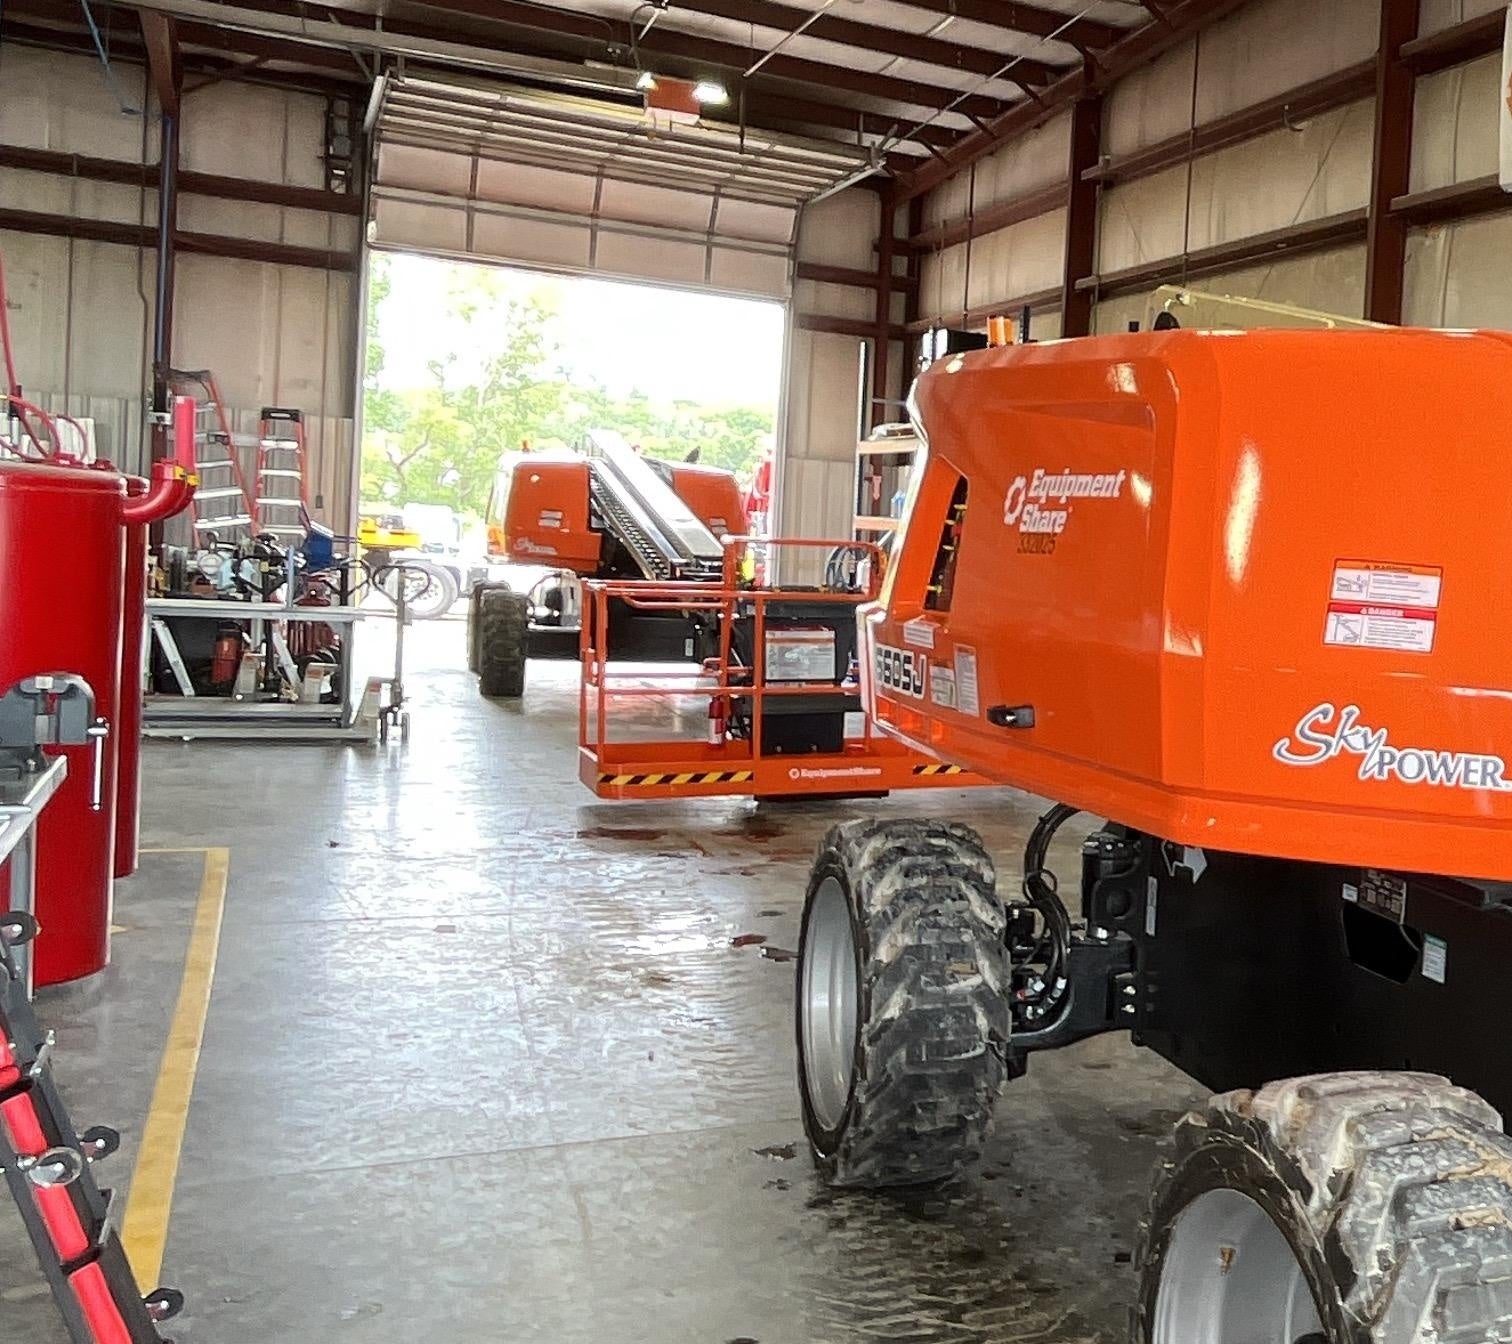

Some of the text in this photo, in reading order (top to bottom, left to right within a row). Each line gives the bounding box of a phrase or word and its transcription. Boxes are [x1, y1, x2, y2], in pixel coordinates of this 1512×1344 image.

[1028, 468, 1126, 504] Equipment
[1019, 503, 1067, 533] Share
[1273, 703, 1508, 789] Sky POWER
